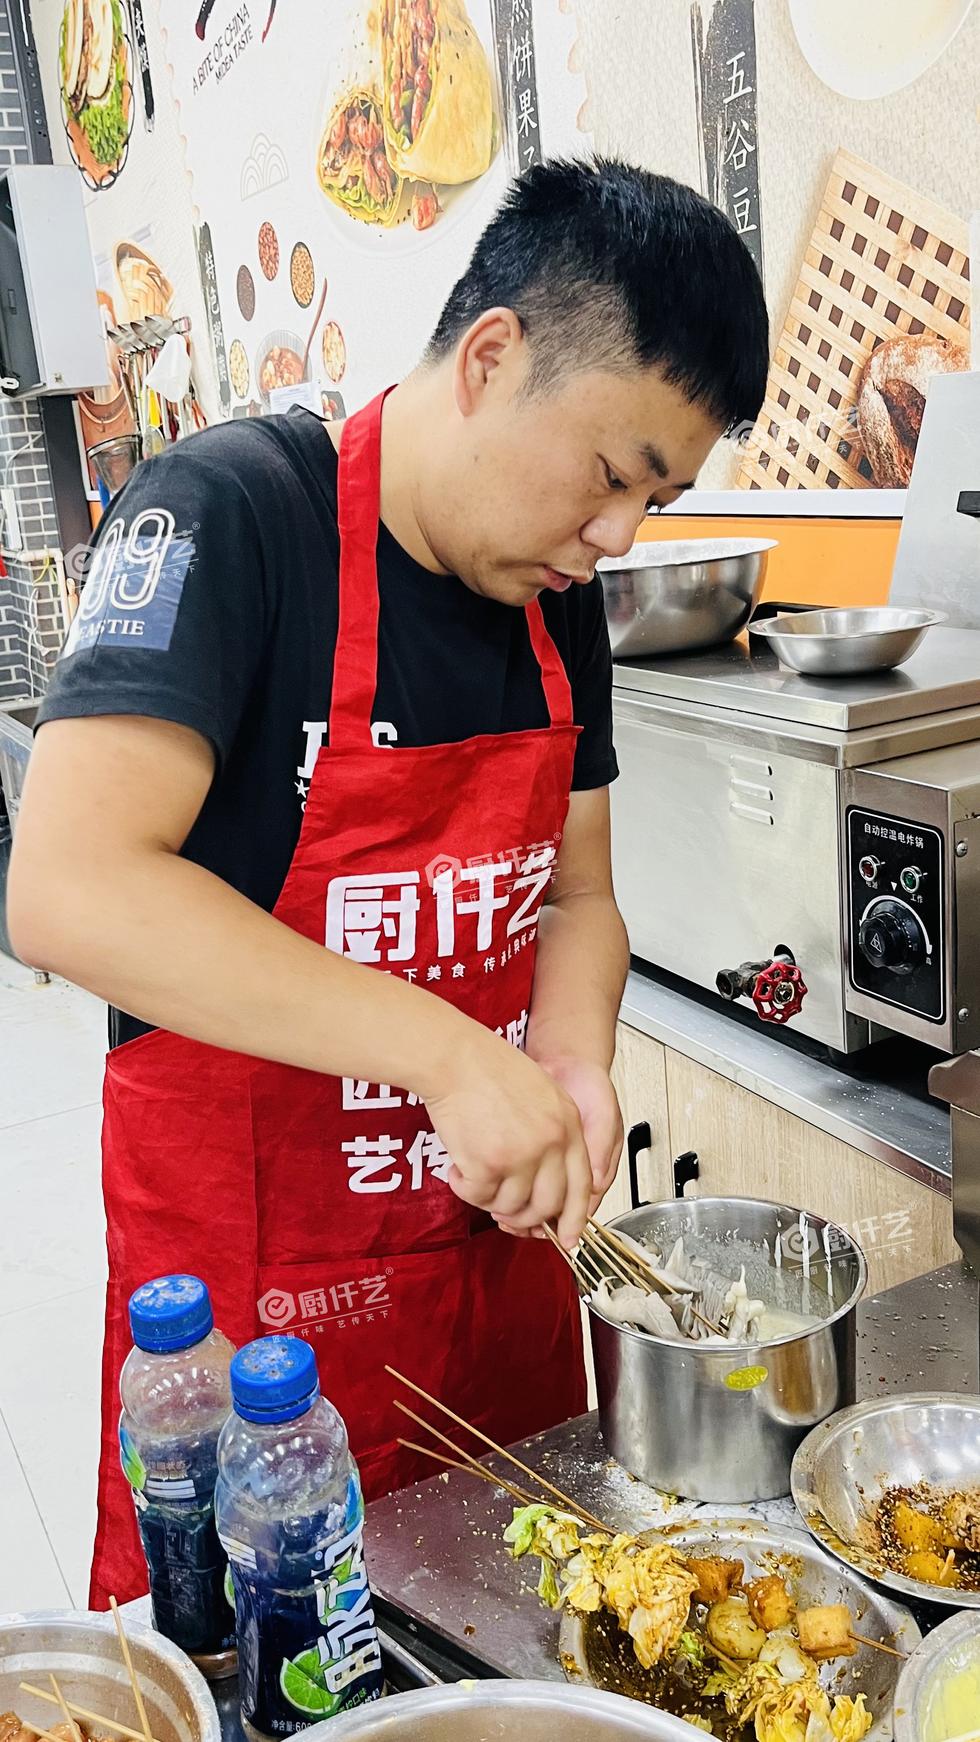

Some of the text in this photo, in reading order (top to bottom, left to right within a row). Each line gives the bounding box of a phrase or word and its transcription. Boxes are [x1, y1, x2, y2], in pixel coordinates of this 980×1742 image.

[193, 3, 250, 96] A BITE OF CHINA
[233, 24, 254, 59] TASTE
[722, 51, 758, 235] 五谷豆
[864, 822, 924, 849] 自动控温电炸锅
[325, 847, 556, 963] 厨仟艺
[910, 893, 924, 903] 工作
[384, 962, 467, 984] 下美食
